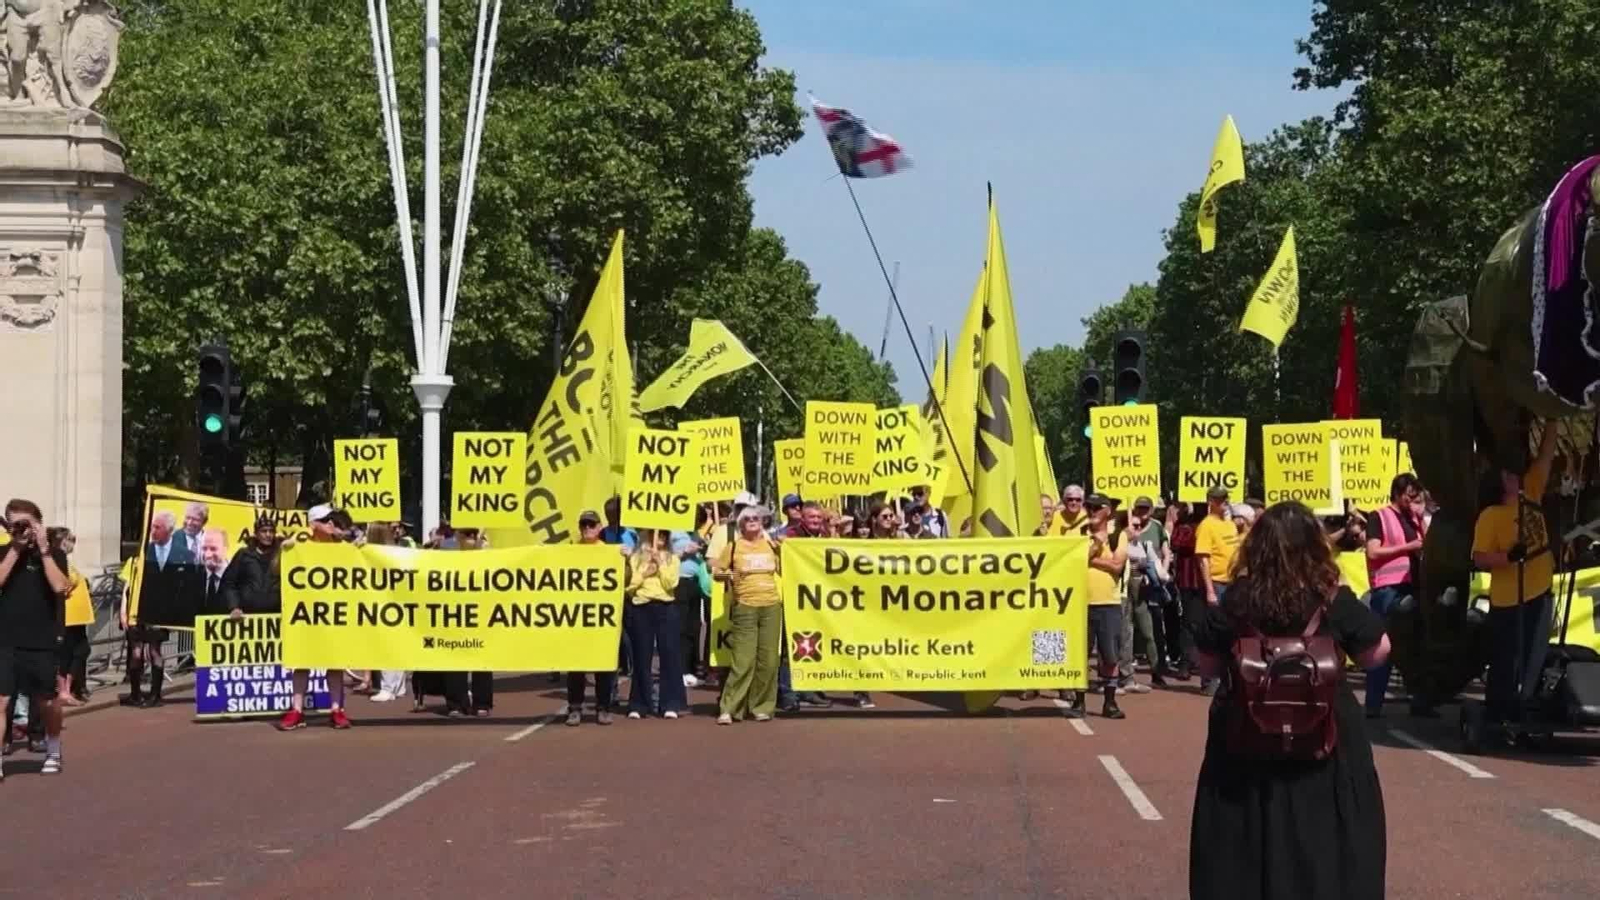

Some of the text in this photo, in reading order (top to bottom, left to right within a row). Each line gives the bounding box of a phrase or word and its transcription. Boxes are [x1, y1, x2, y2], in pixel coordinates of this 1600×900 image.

[815, 411, 867, 425] DOWN
[1100, 415, 1150, 429] DOWN
[539, 400, 582, 474] THE
[686, 427, 734, 441] OWN
[819, 431, 862, 445] WITH
[1191, 422, 1235, 440] NOT
[1272, 433, 1323, 446] DOWN
[464, 438, 515, 458] NOT
[638, 434, 691, 458] NOT
[876, 434, 906, 454] MY
[1105, 434, 1146, 448] WITH
[344, 444, 388, 462] NOT
[783, 447, 805, 460] DO
[823, 451, 854, 466] THE
[1111, 454, 1142, 468] THE
[1195, 446, 1229, 464] MY
[1277, 451, 1318, 464] WITH
[351, 468, 383, 485] MY
[470, 466, 508, 485] MY
[642, 462, 681, 485] MY
[806, 470, 871, 486] CROWN
[1096, 474, 1158, 490] CROWN
[1184, 470, 1238, 489] KING
[1283, 469, 1314, 483] THE
[697, 479, 744, 494] ROWN
[1341, 478, 1381, 491] OWN
[341, 491, 395, 509] KING
[457, 492, 518, 513] KING
[628, 490, 691, 515] KING
[1268, 487, 1331, 503] CROWN
[825, 548, 1047, 580] Democracy
[288, 566, 619, 592] CORRUPT BILLIONAIRES
[797, 581, 1074, 615] Not Monarchy
[290, 601, 617, 628] ARE NOT THE ANSWER
[204, 617, 281, 641] KOHIN
[437, 638, 485, 650] Republic
[830, 638, 975, 661] Republic Kent
[211, 641, 282, 665] DIAM
[208, 665, 275, 681] STOLEN
[1019, 667, 1082, 680] WhatsApp
[206, 683, 218, 697] A
[225, 682, 245, 696] 10
[227, 693, 314, 712] SIKH KIG
